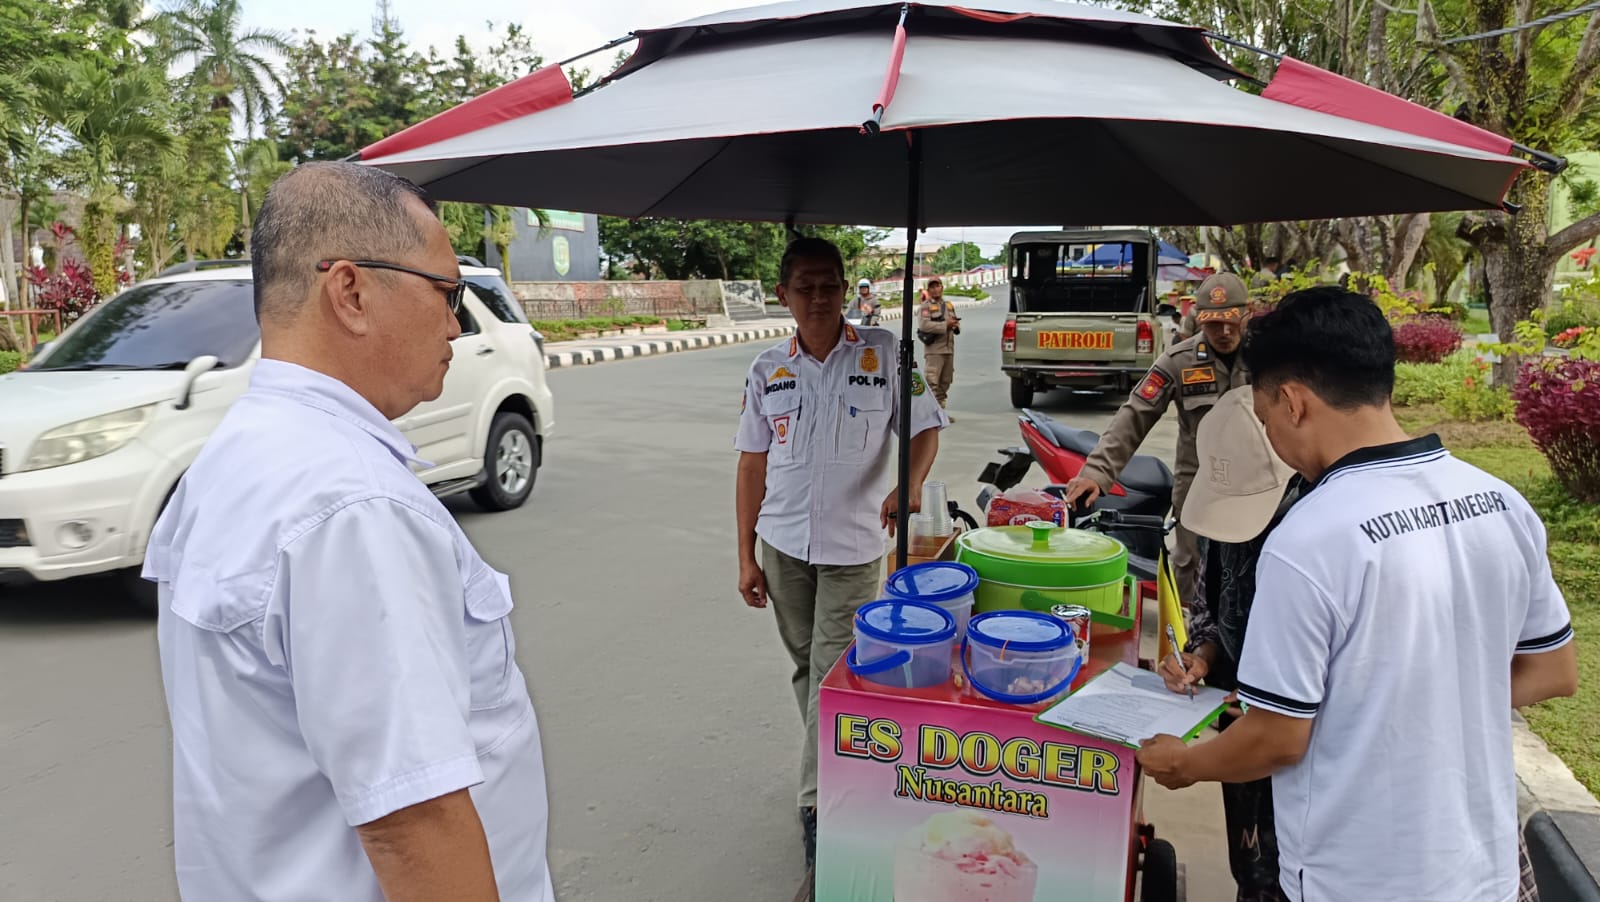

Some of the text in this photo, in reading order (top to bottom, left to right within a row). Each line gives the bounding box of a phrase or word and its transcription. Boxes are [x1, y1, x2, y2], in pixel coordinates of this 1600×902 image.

[1038, 331, 1114, 350] PATROLI
[849, 375, 887, 388] POL PP
[1359, 509, 1415, 544] KUTAI
[836, 714, 1120, 795] ES DOGER
[896, 765, 1049, 818] Nusantara
